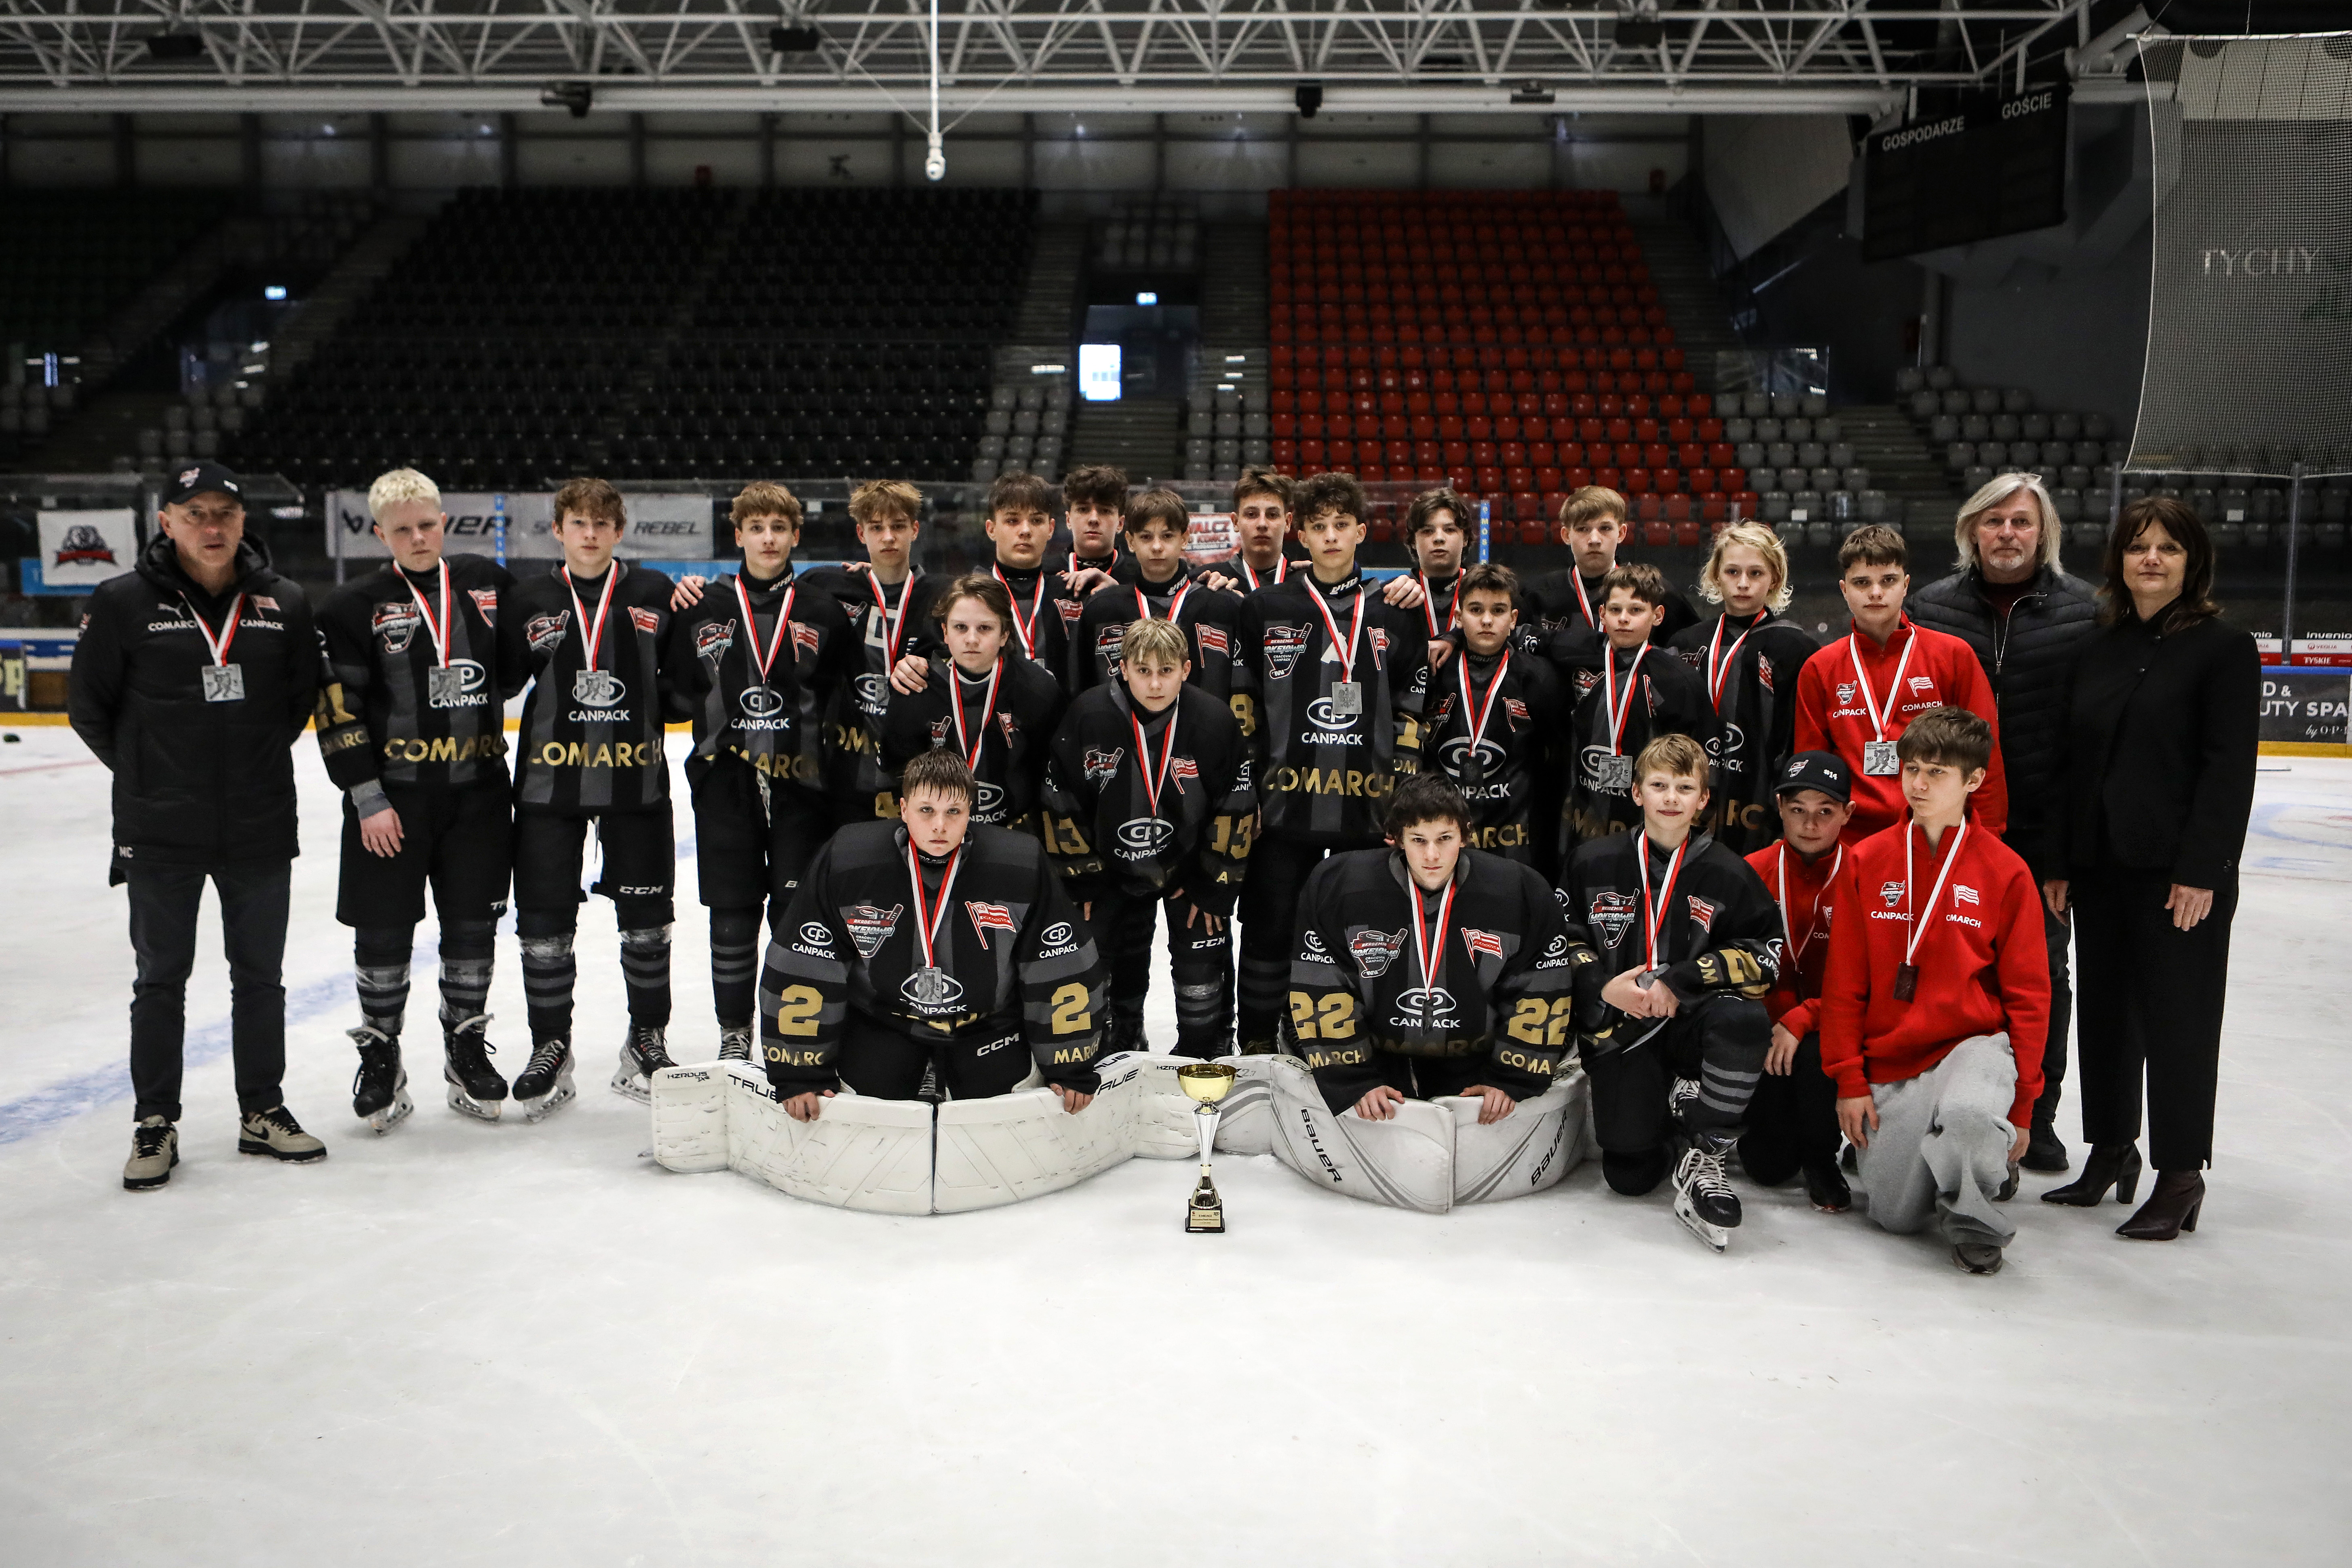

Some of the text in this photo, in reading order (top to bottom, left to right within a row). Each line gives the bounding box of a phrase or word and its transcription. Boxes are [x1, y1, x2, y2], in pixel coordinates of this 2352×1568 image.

[1882, 116, 1966, 152] GOSPODARZE
[633, 521, 702, 535] REBEL
[148, 619, 197, 631] COMARC
[240, 618, 284, 631] CANPACK
[2304, 656, 2331, 665] TYSKIE
[1833, 708, 1866, 718] CANPACK
[1902, 701, 1943, 711] COMARCH
[2307, 701, 2349, 717] SPA
[568, 709, 630, 721] CANPACK
[731, 718, 790, 730] CANPACK
[1302, 732, 1363, 745] CANPACK
[1823, 769, 1838, 780] #14
[1268, 767, 1395, 798] OMARCH
[970, 809, 1007, 824] NPACK
[1212, 812, 1254, 859] 13
[1470, 823, 1529, 849] ARCH
[1114, 842, 1169, 861] CANPAC
[619, 885, 664, 895] CCM
[982, 915, 1008, 923] CRACOVIA
[1871, 911, 1914, 922] CANPACK
[1946, 914, 1982, 929] CMARCH
[1039, 942, 1079, 958] CANPACK
[1192, 936, 1226, 949] CCM
[792, 943, 835, 960] CANPACK
[1301, 952, 1335, 964] CANPACK
[1351, 948, 1398, 958] HOKEJOWA
[1536, 957, 1569, 969] CANPACK
[778, 984, 823, 1036] 2
[1051, 982, 1091, 1035] 2
[1289, 991, 1356, 1040] 22
[1389, 1017, 1461, 1028] CANACK
[1507, 996, 1572, 1045] 22
[977, 1033, 1020, 1057] CCM
[1054, 1037, 1100, 1064] MARCH
[762, 1045, 825, 1066] COMARC
[1309, 1047, 1366, 1069] MARCH
[1500, 1050, 1551, 1075] COMA
[728, 1073, 777, 1101] TRUE
[1097, 1068, 1139, 1095] RUE
